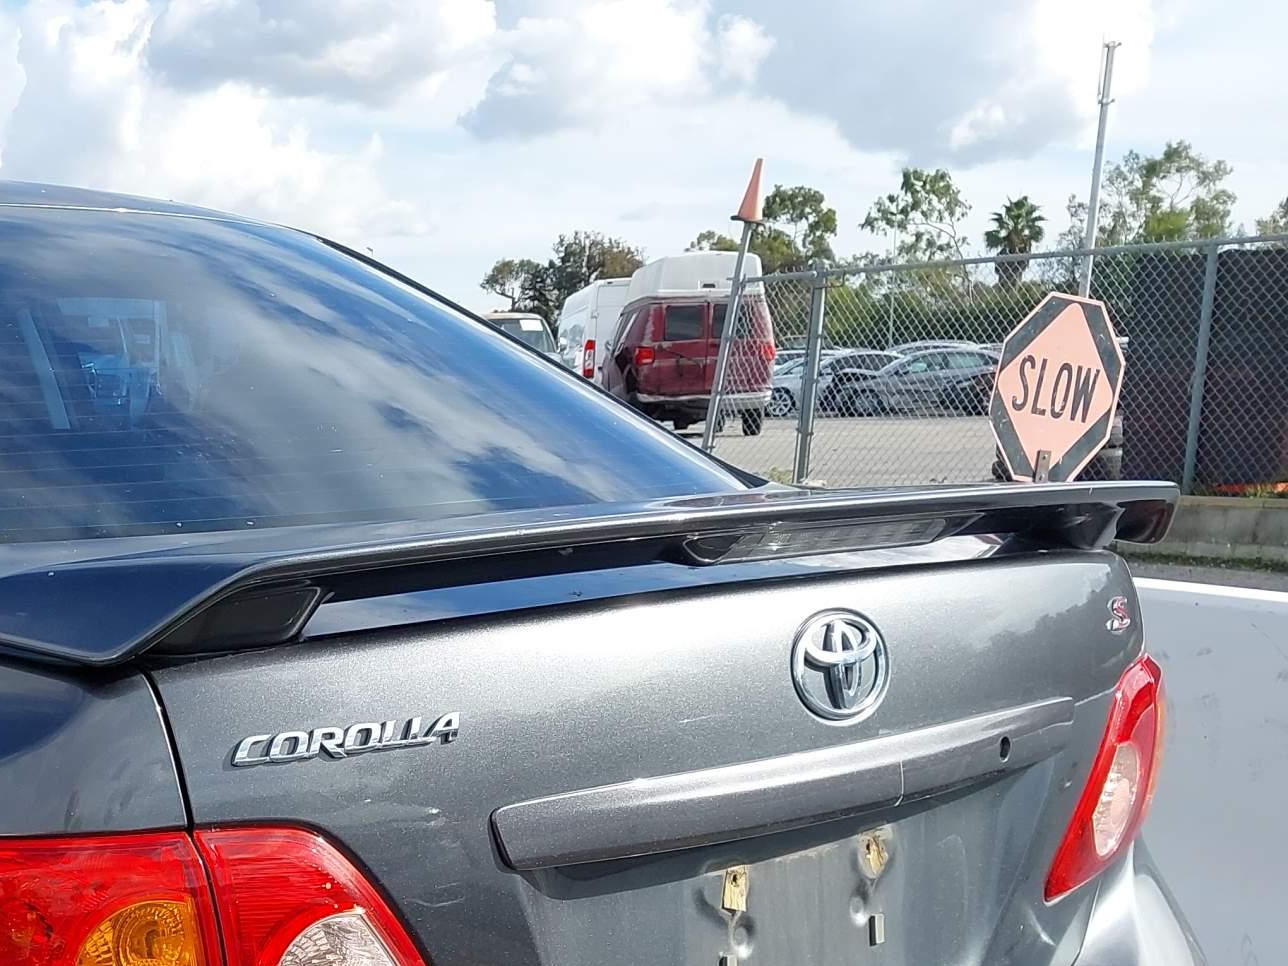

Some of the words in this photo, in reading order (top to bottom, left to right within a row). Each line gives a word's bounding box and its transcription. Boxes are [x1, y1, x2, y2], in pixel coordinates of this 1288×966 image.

[1011, 354, 1101, 424] SLOW
[1105, 595, 1131, 633] S
[230, 711, 461, 768] COROLLA
